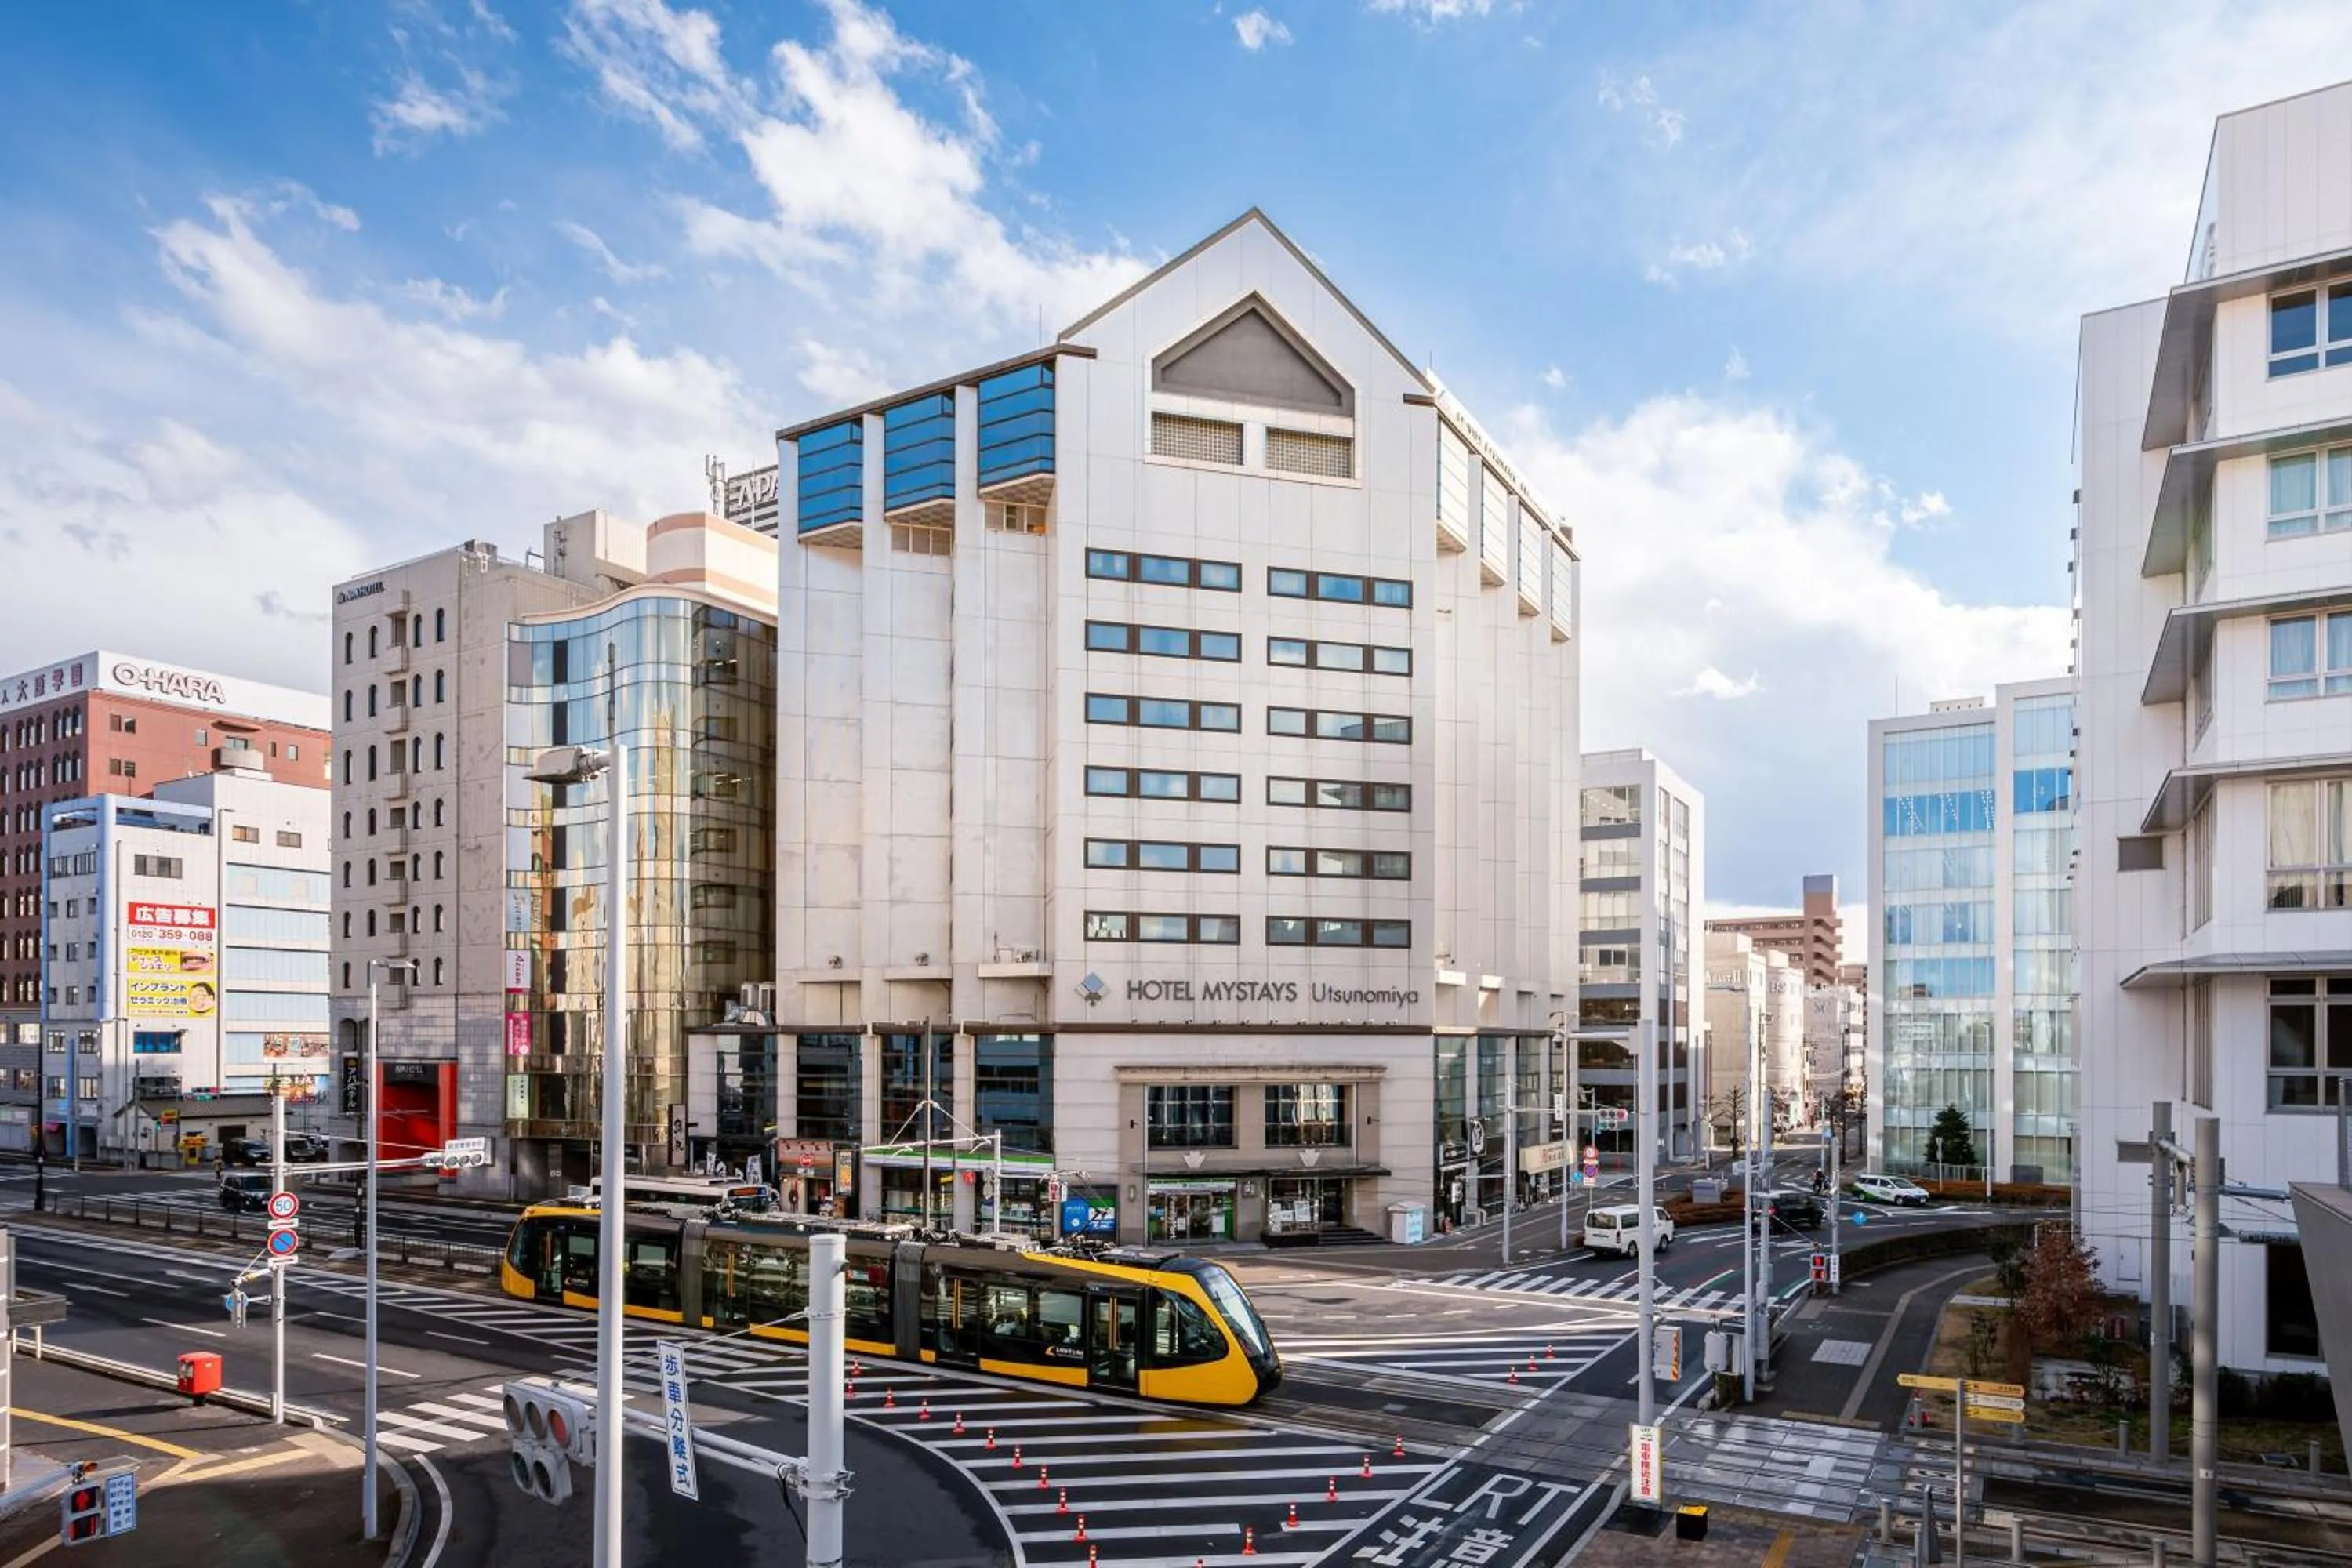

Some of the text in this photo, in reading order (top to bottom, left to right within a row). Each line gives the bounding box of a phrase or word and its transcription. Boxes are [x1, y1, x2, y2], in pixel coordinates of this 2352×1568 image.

[135, 906, 210, 926] 広告募集
[1127, 980, 1419, 1008] HOTEL MYSTAYS Utsunomiya
[275, 1199, 292, 1212] 50
[665, 1354, 690, 1488] 歩車分離式
[1410, 1467, 1581, 1526] LRT
